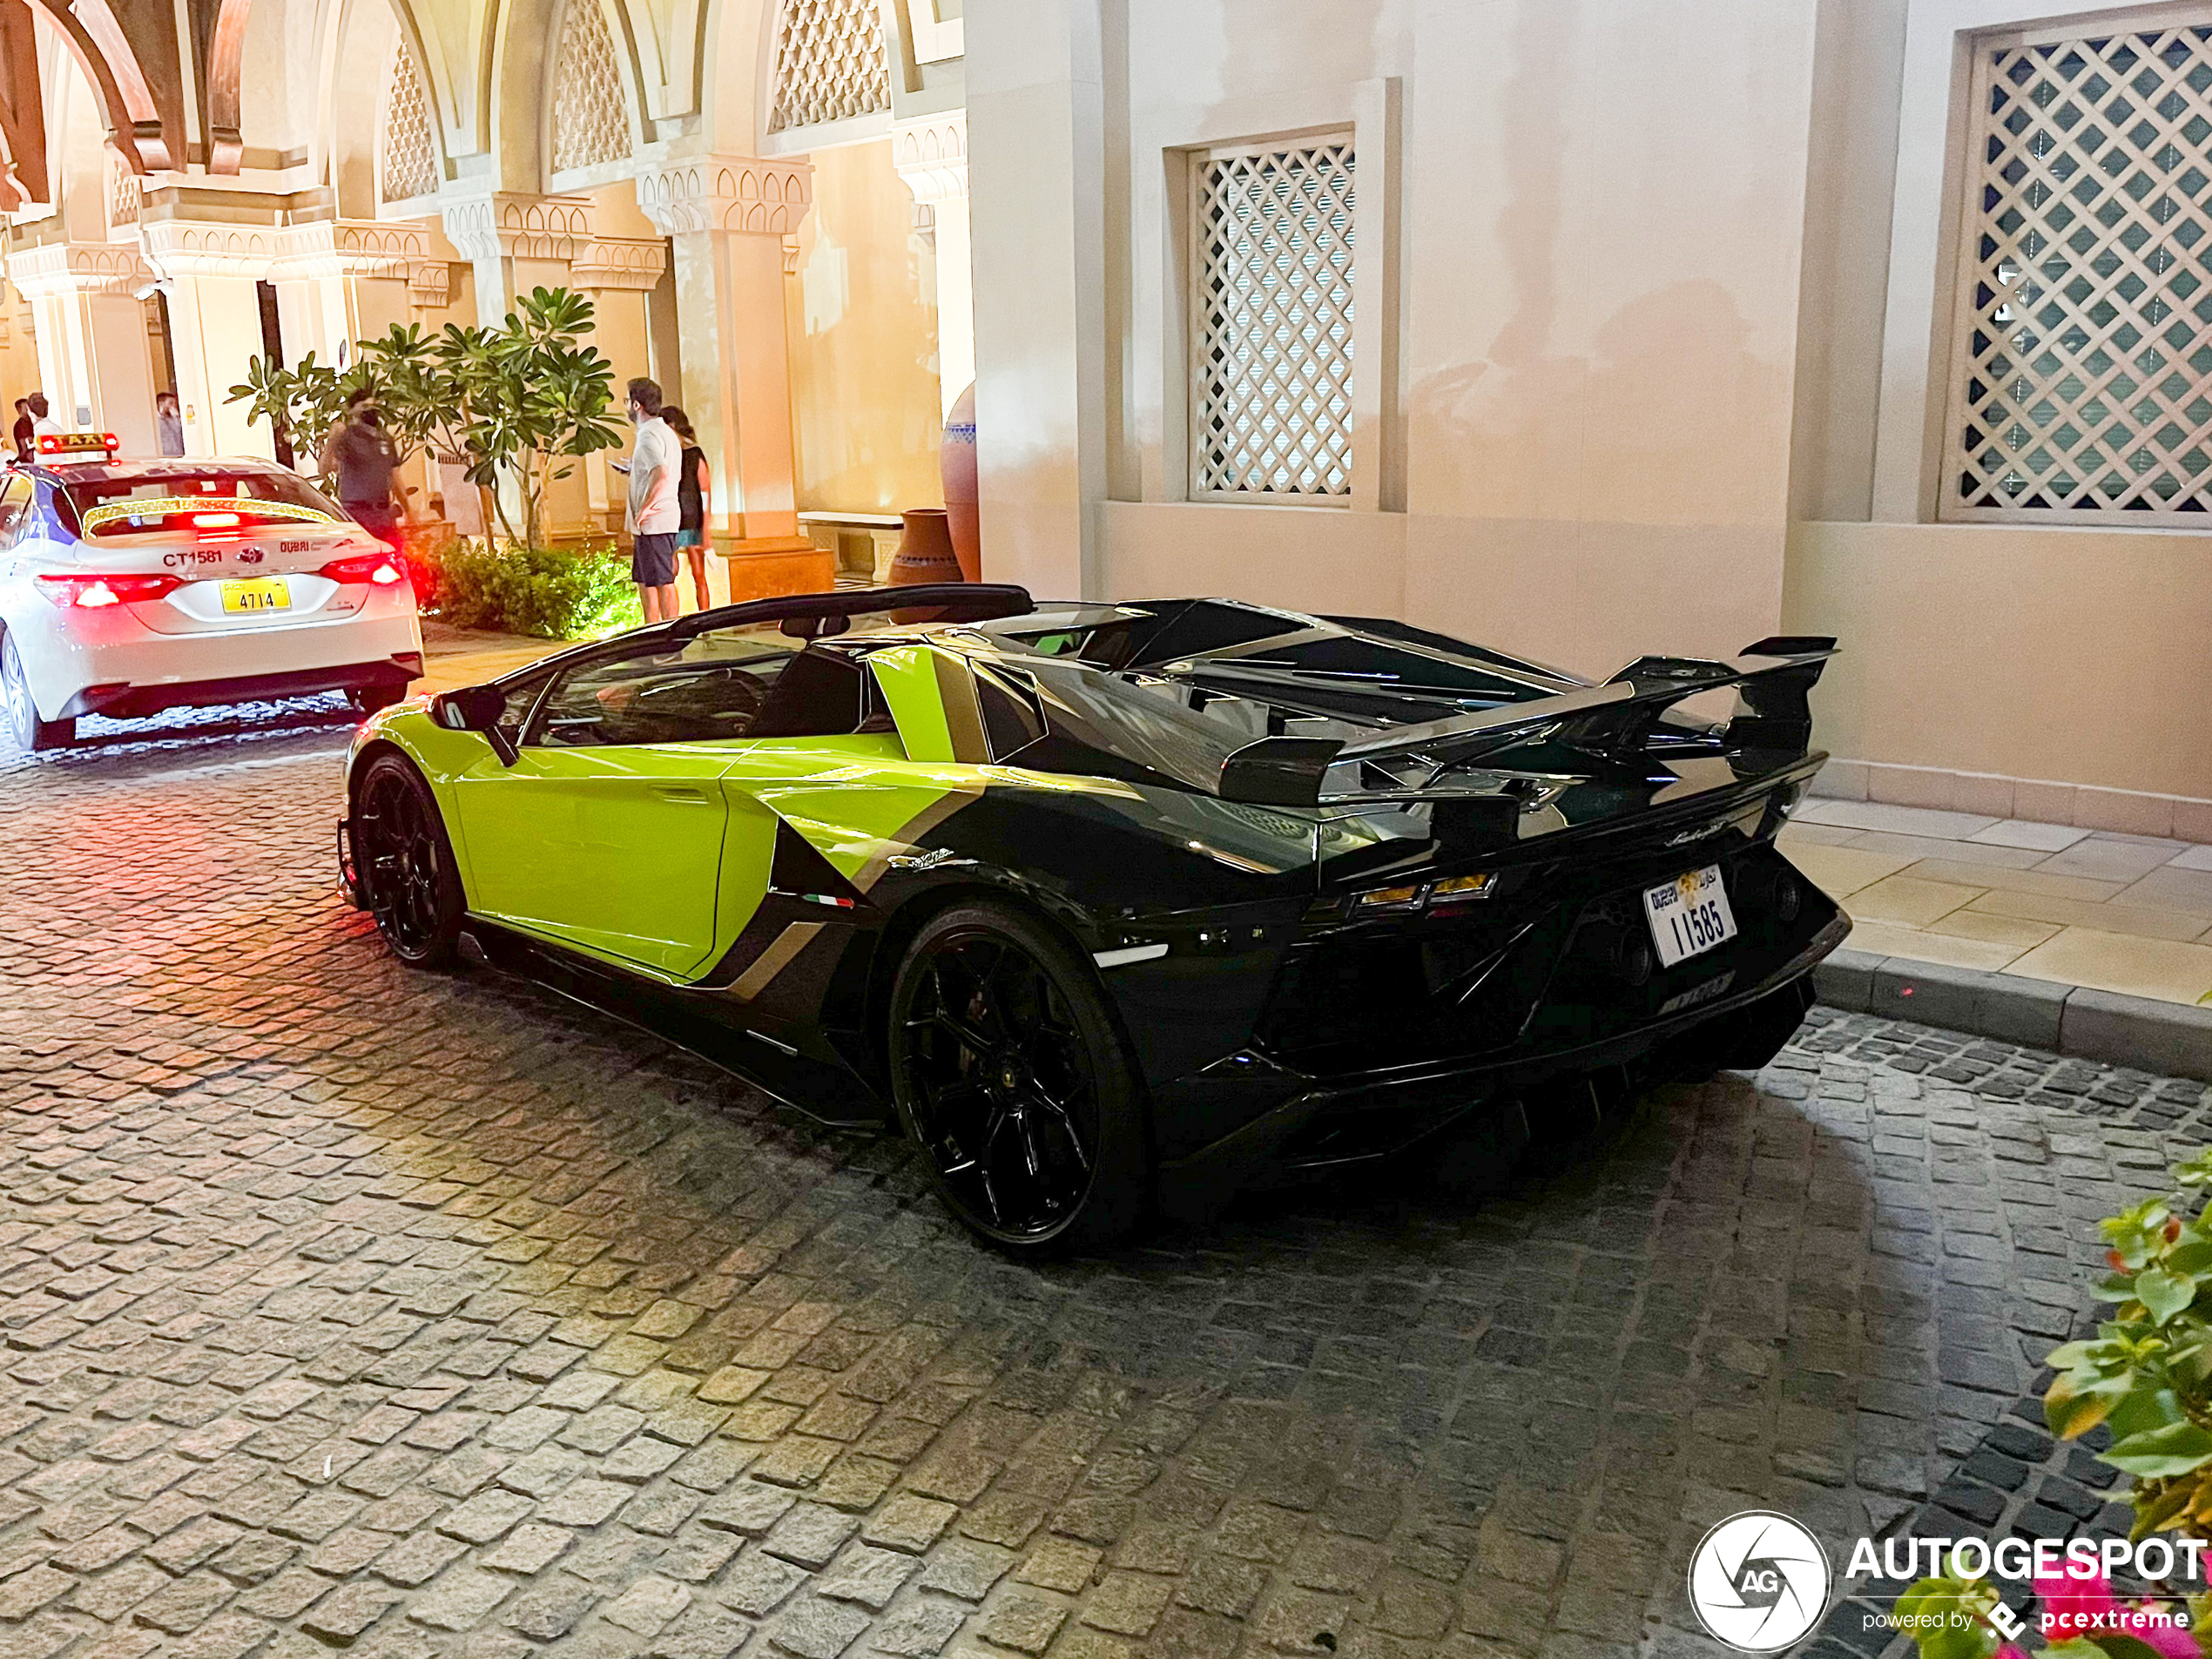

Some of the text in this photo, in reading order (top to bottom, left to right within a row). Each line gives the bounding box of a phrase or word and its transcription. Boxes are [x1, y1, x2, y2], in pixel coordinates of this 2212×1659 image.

[163, 550, 222, 567] CT1581
[240, 593, 274, 609] 4714
[1670, 900, 1724, 956] 11585
